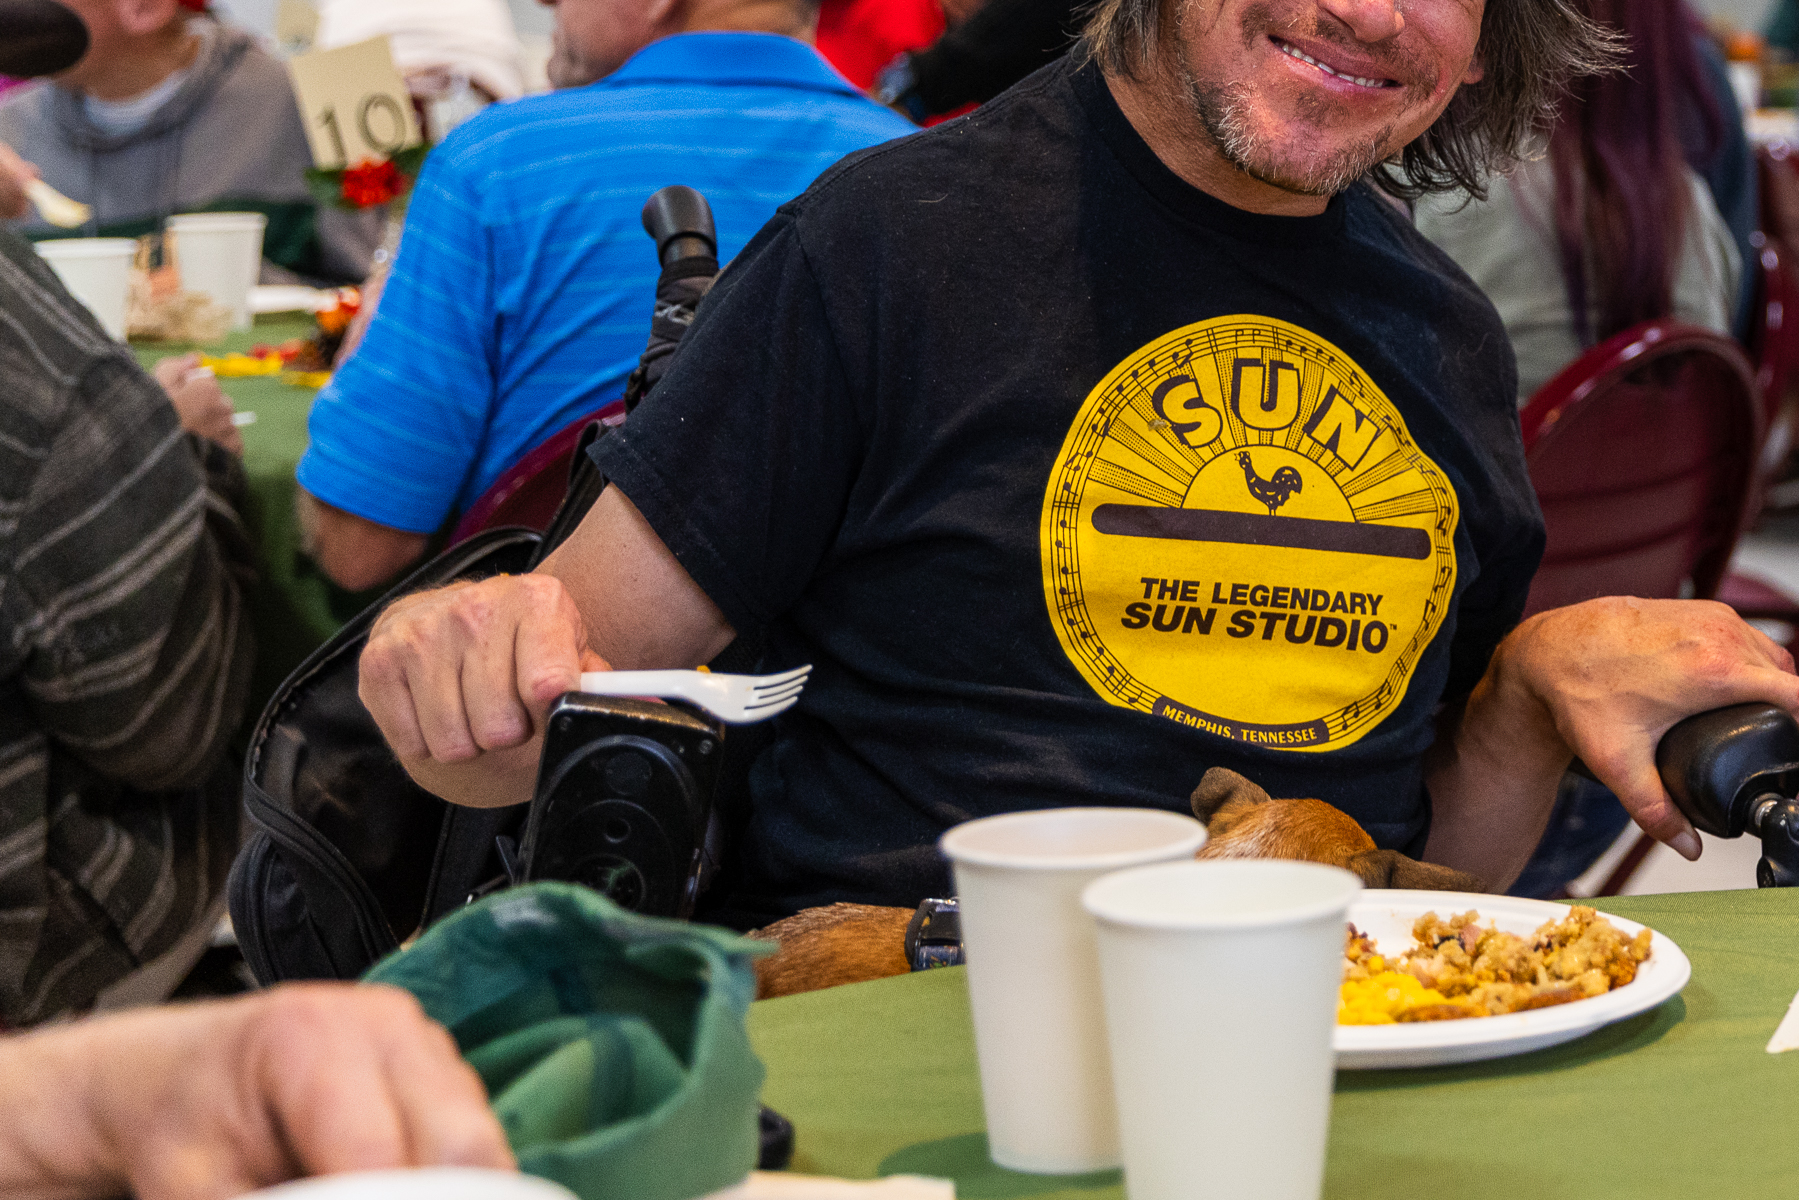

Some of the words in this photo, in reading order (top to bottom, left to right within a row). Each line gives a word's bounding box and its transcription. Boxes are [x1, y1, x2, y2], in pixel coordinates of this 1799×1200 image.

[316, 93, 407, 169] 10
[1149, 357, 1381, 472] SUN
[1140, 577, 1200, 603] THE
[1211, 582, 1384, 616] LEGENDARY
[1121, 602, 1218, 636] SUN
[1240, 727, 1318, 744] TENNESSEE
